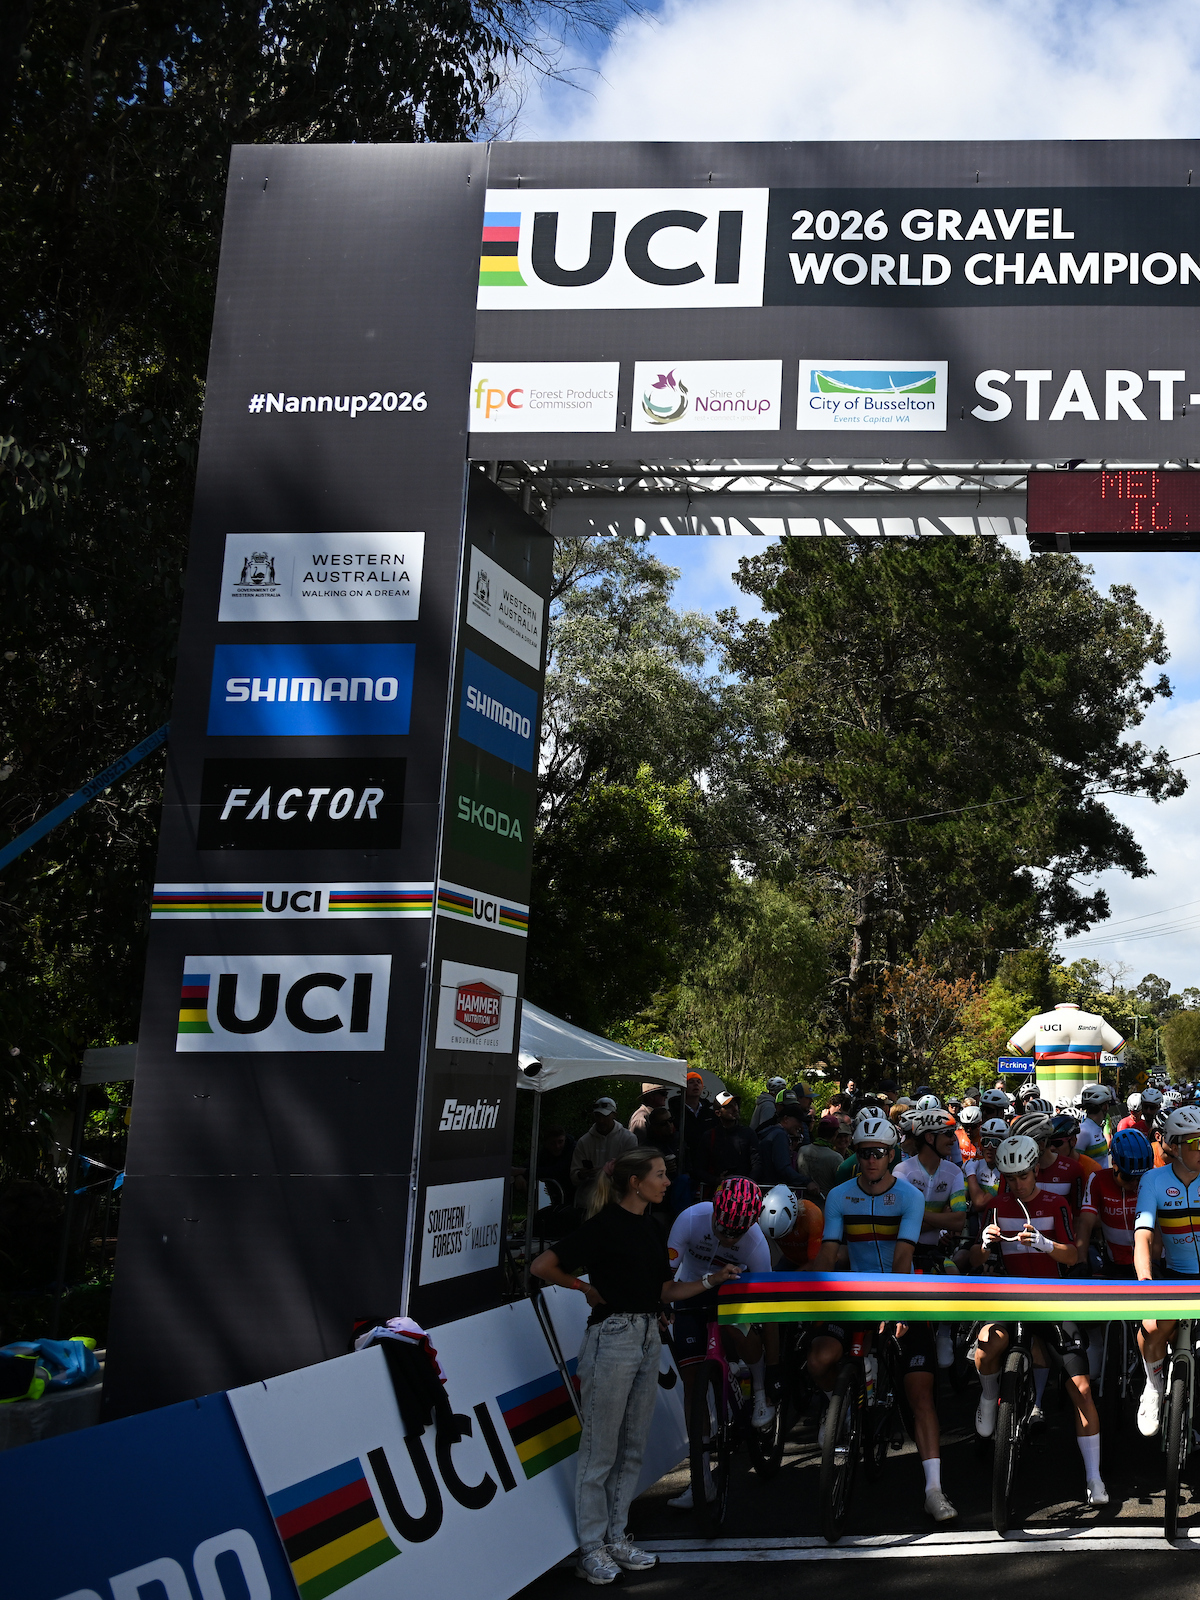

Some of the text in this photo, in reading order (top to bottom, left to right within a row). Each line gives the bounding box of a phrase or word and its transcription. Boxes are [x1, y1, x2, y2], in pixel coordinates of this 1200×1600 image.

[791, 208, 1074, 241] 2026 GRAVEL
[532, 210, 743, 286] UCI
[790, 253, 951, 287] WORLD
[247, 391, 428, 418] #Nannup2026
[474, 378, 524, 419] fpc
[529, 388, 614, 399] Forest Products
[529, 399, 593, 409] Commission
[695, 396, 771, 414] Nannup
[709, 388, 746, 398] Shire of
[809, 396, 935, 414] City of Busselton
[833, 415, 911, 424] Events Capital WA
[312, 554, 405, 566] WESTERN
[302, 571, 411, 583] AUSTRALIA
[374, 589, 410, 597] DREAM
[503, 588, 537, 621] WESTERN
[499, 602, 538, 637] AUSTRALIA
[225, 676, 399, 703] SHIMANO
[466, 686, 532, 740] SHIMANO
[220, 786, 385, 822] FACTOR
[265, 890, 322, 913] UCI
[474, 897, 498, 924] UCI
[216, 973, 373, 1034] UCI
[457, 993, 499, 1016] HAMMER
[463, 1014, 491, 1025] NUTRITION
[1043, 1024, 1062, 1032] UCI
[451, 1035, 499, 1047] ENDURANCE FUELS
[1000, 1062, 1028, 1070] Parking
[438, 1099, 501, 1132] Santini
[1179, 1111, 1193, 1123] MET
[427, 1205, 465, 1234] SOUTHERN
[432, 1230, 463, 1258] FORESTS
[471, 1223, 498, 1250] VALLEYS
[367, 1402, 517, 1543] UCI
